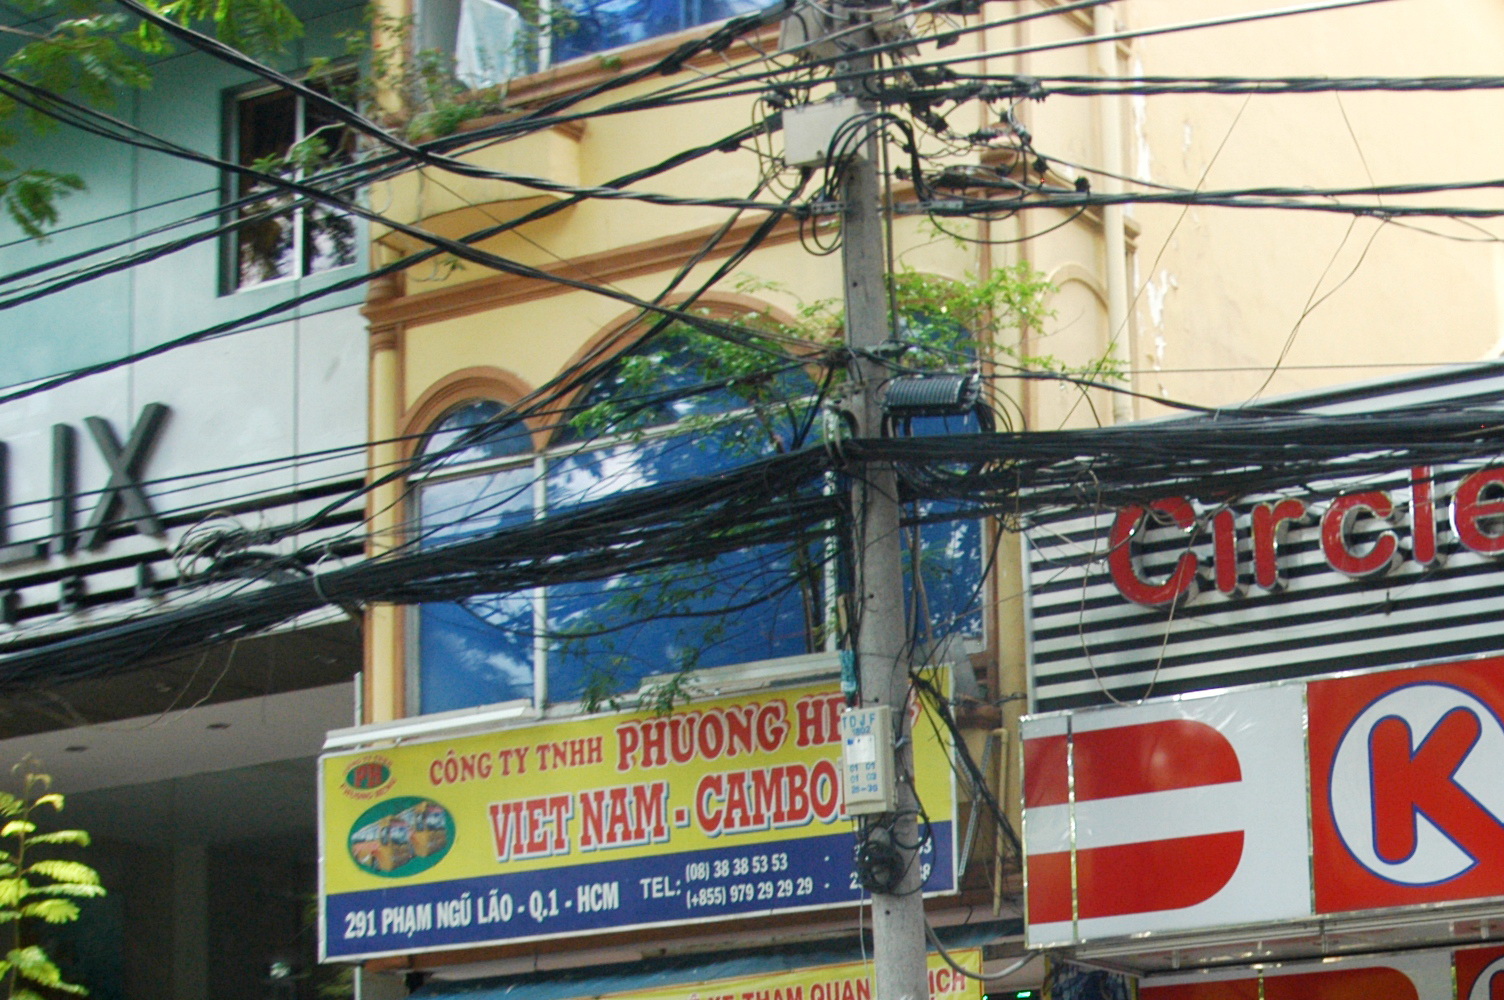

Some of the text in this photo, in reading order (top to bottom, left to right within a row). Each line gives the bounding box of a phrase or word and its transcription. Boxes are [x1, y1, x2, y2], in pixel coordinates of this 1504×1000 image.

[429, 750, 494, 787] CÔNG
[499, 746, 531, 776] TY
[536, 736, 604, 771] TNHH
[489, 796, 572, 862] VIET
[579, 782, 669, 847] NAM
[344, 853, 788, 939] 291 PHẠM NGŨ LÃO Q.1 HCM TEL: (08) 38 38 53 53
[685, 876, 814, 909] (+855) 979 29 29 29
